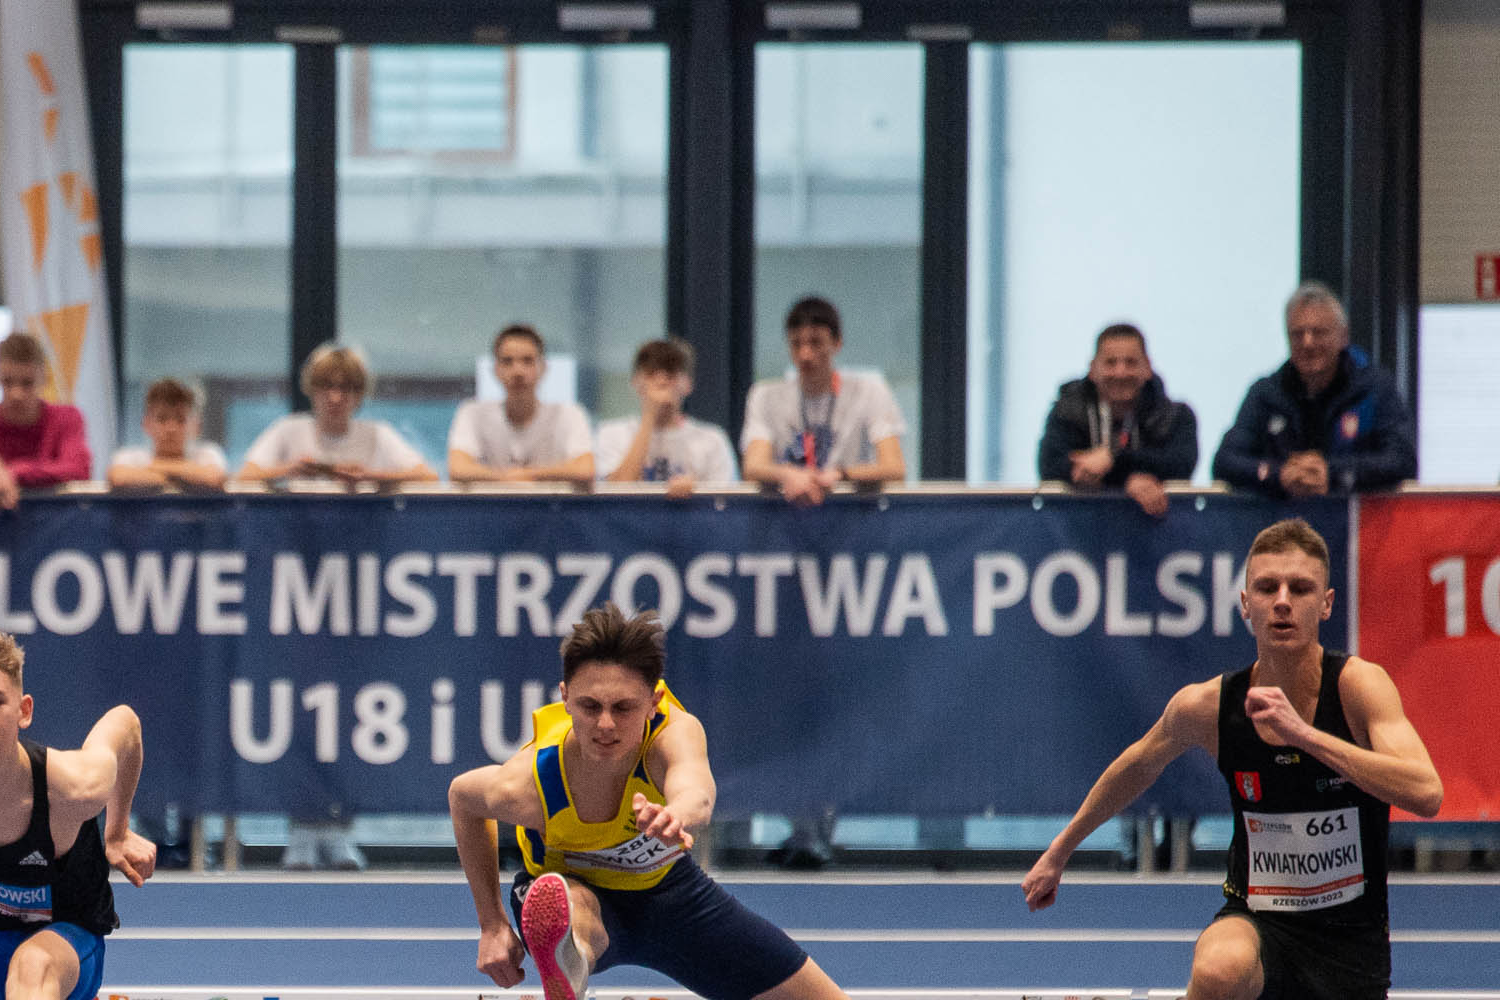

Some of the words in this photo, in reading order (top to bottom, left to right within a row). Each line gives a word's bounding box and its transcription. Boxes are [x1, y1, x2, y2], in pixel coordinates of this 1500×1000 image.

[269, 551, 949, 638] MISTRZOSTWA
[972, 551, 1256, 638] POLSK
[228, 678, 410, 766] U18
[431, 678, 456, 765] i
[1306, 814, 1348, 837] 661
[1252, 844, 1358, 875] KWIATKOWSKI
[1272, 896, 1320, 907] RZESZÓW
[1321, 891, 1344, 904] 2023
